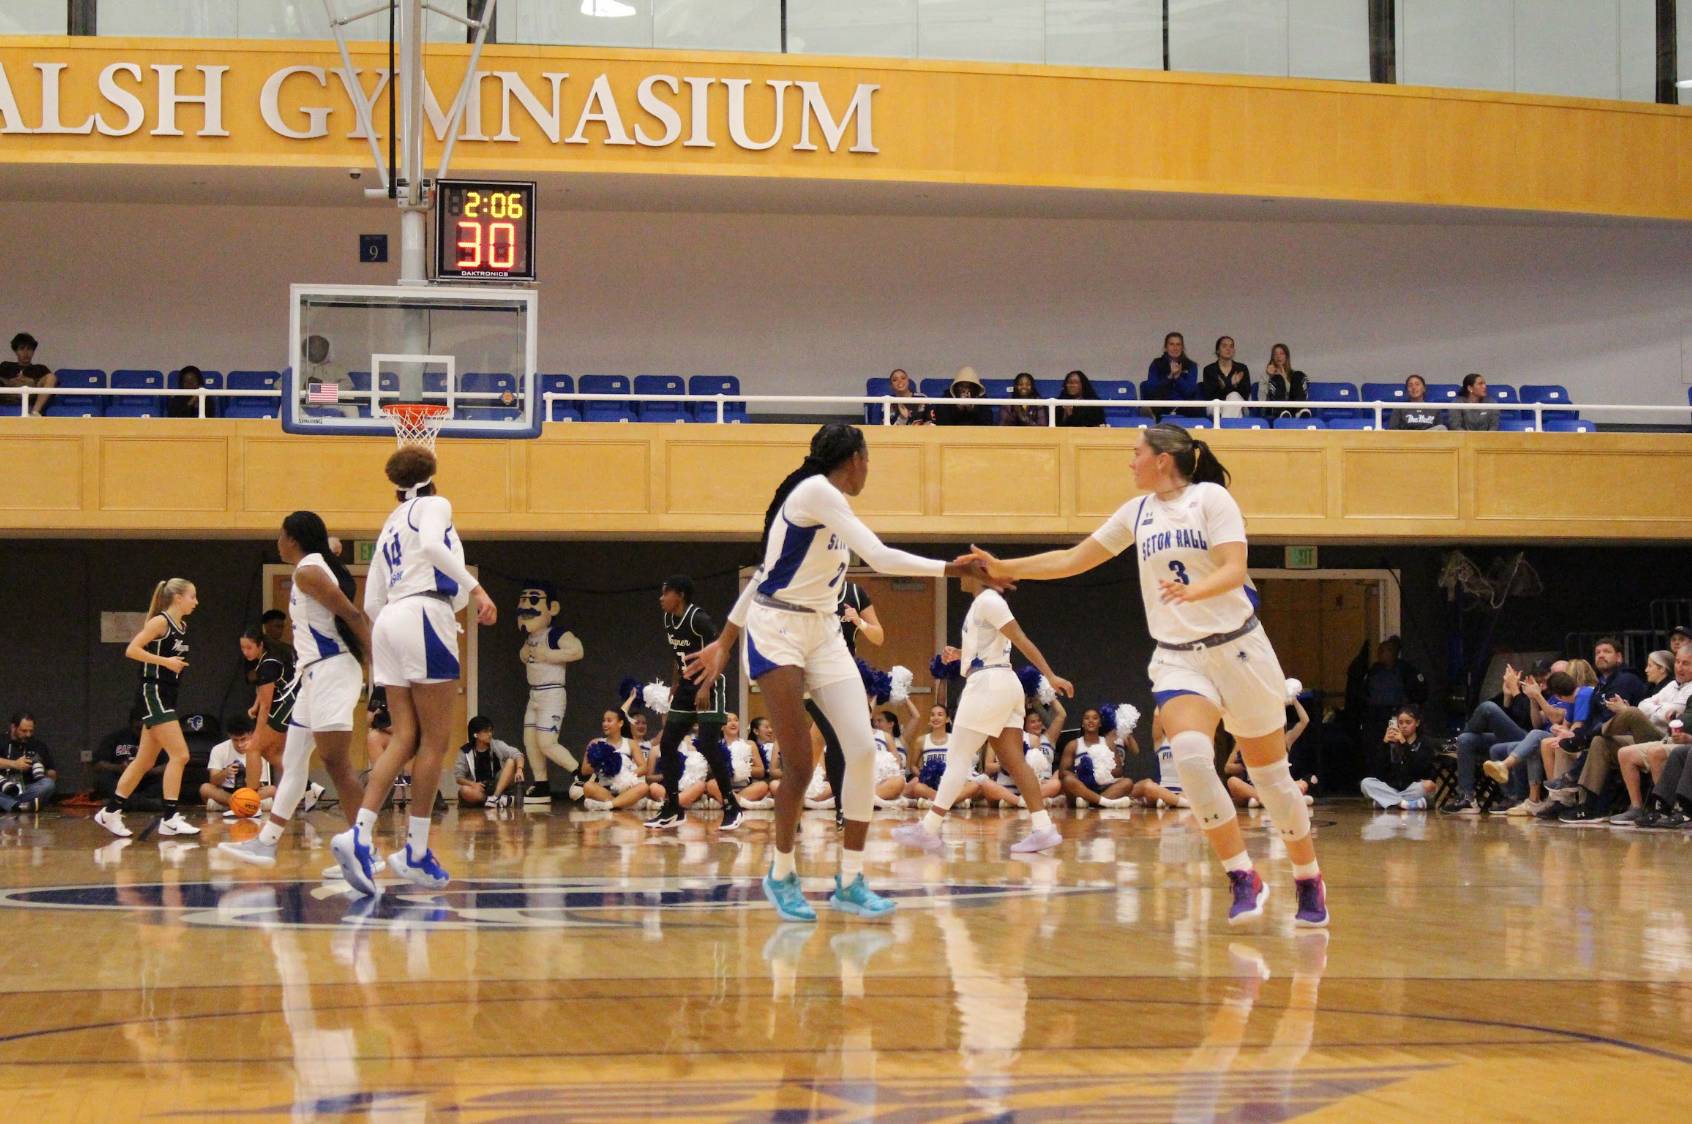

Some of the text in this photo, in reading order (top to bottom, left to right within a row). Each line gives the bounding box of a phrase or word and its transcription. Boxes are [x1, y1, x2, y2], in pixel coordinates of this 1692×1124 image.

[259, 64, 881, 154] GYMNASIUM
[464, 191, 523, 219] 2:06
[368, 245, 379, 261] 9
[457, 222, 515, 268] 30
[382, 532, 402, 575] 14
[1142, 529, 1208, 561] SETON HALL
[1168, 560, 1190, 586] 3
